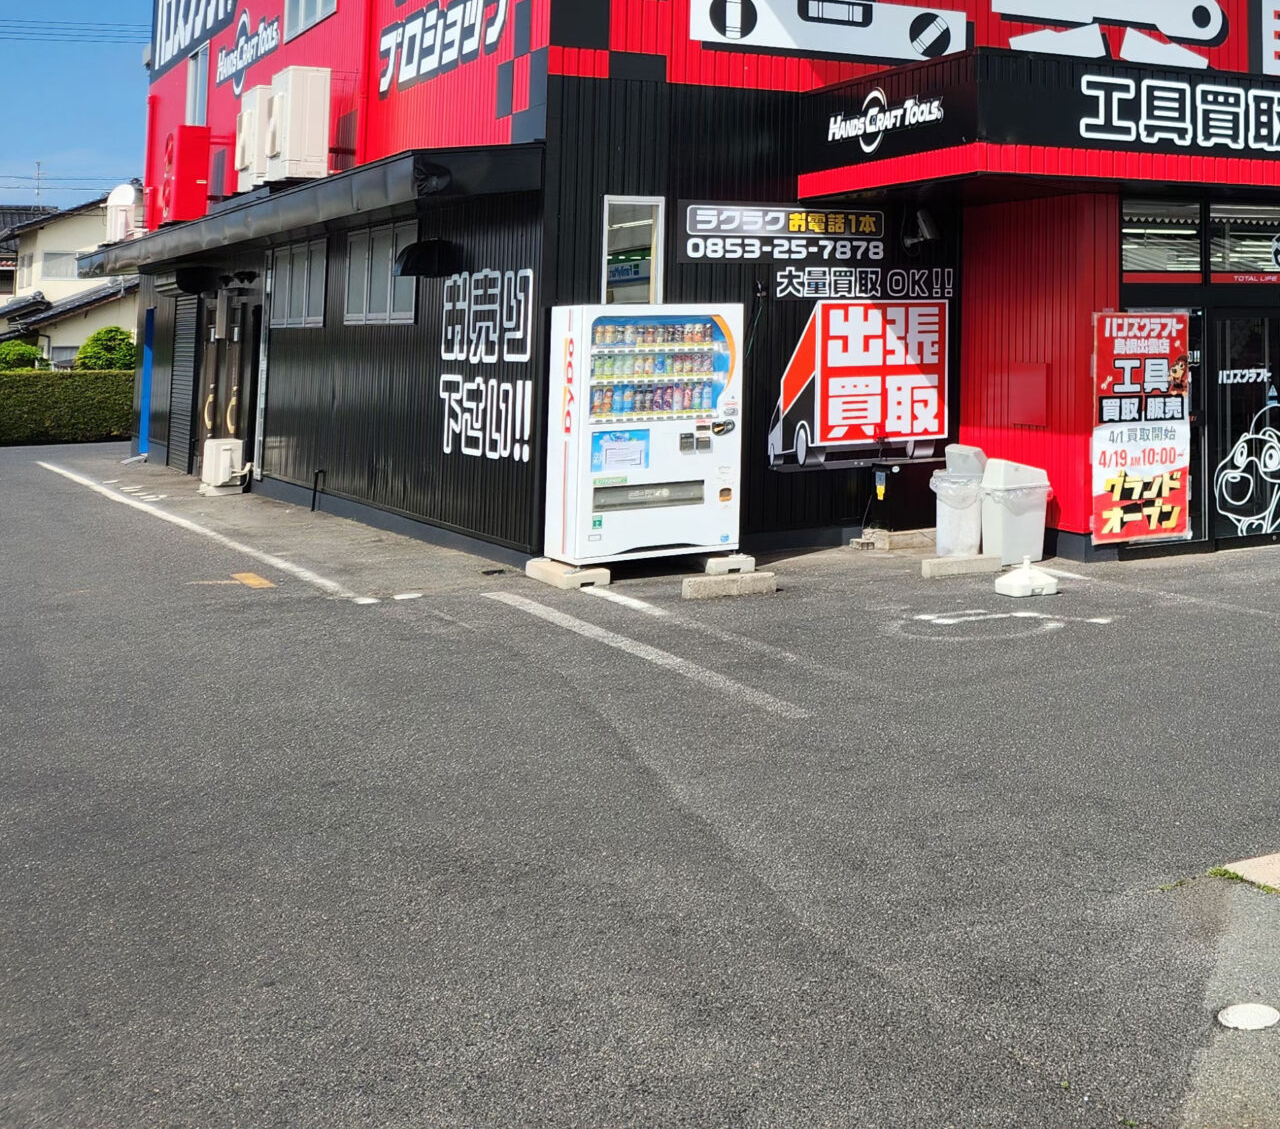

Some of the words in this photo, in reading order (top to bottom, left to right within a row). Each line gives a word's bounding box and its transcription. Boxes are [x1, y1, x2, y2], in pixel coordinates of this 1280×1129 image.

[686, 238, 885, 260] 0853-25-7878
[441, 268, 533, 364] お売り
[1104, 317, 1184, 338] ハンズクラフト
[827, 306, 939, 367] 出張
[1113, 358, 1169, 393] 工具
[827, 374, 939, 438] 買取
[1102, 397, 1139, 422] 買取
[1146, 397, 1182, 419] 販売
[1104, 469, 1182, 502] グランド
[1101, 498, 1181, 535] オープン
